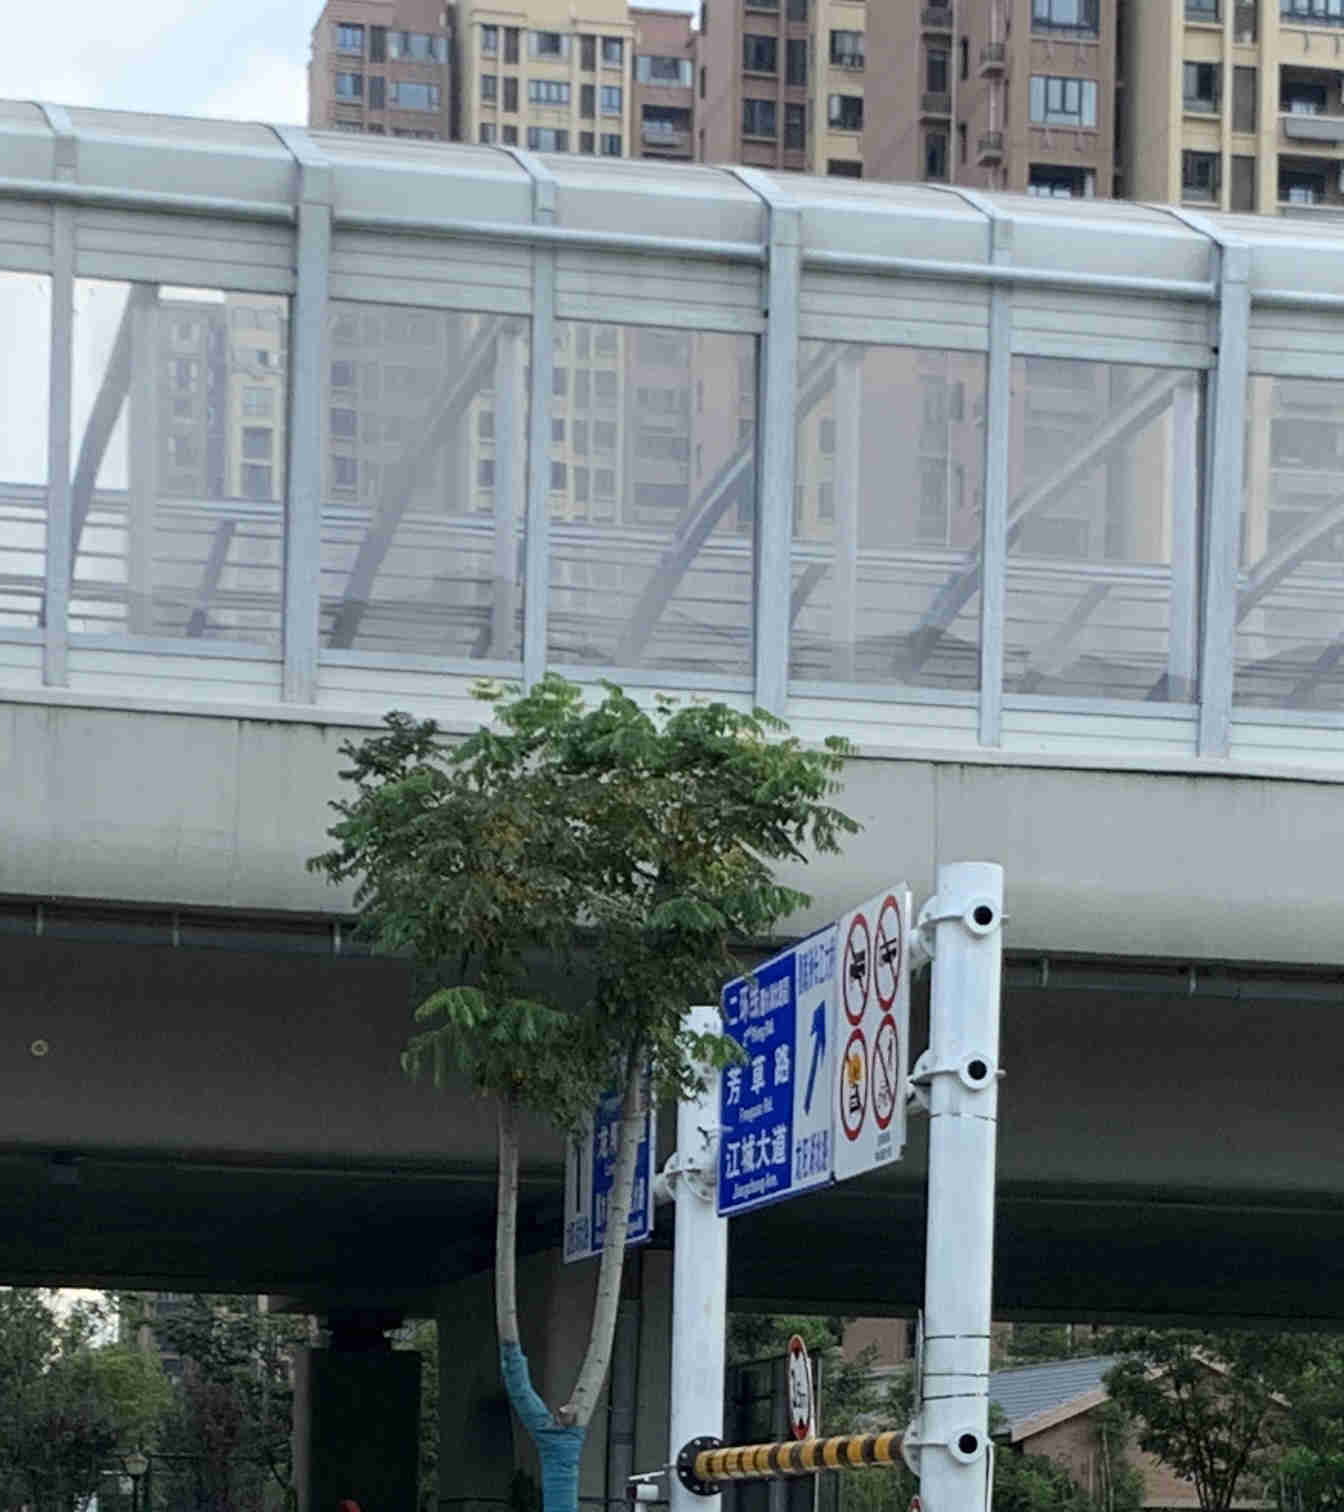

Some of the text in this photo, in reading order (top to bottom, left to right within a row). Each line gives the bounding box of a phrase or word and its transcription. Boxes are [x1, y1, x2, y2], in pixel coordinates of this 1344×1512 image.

[727, 1043, 789, 1105] 芳草路
[726, 1123, 787, 1179] 江城大道
